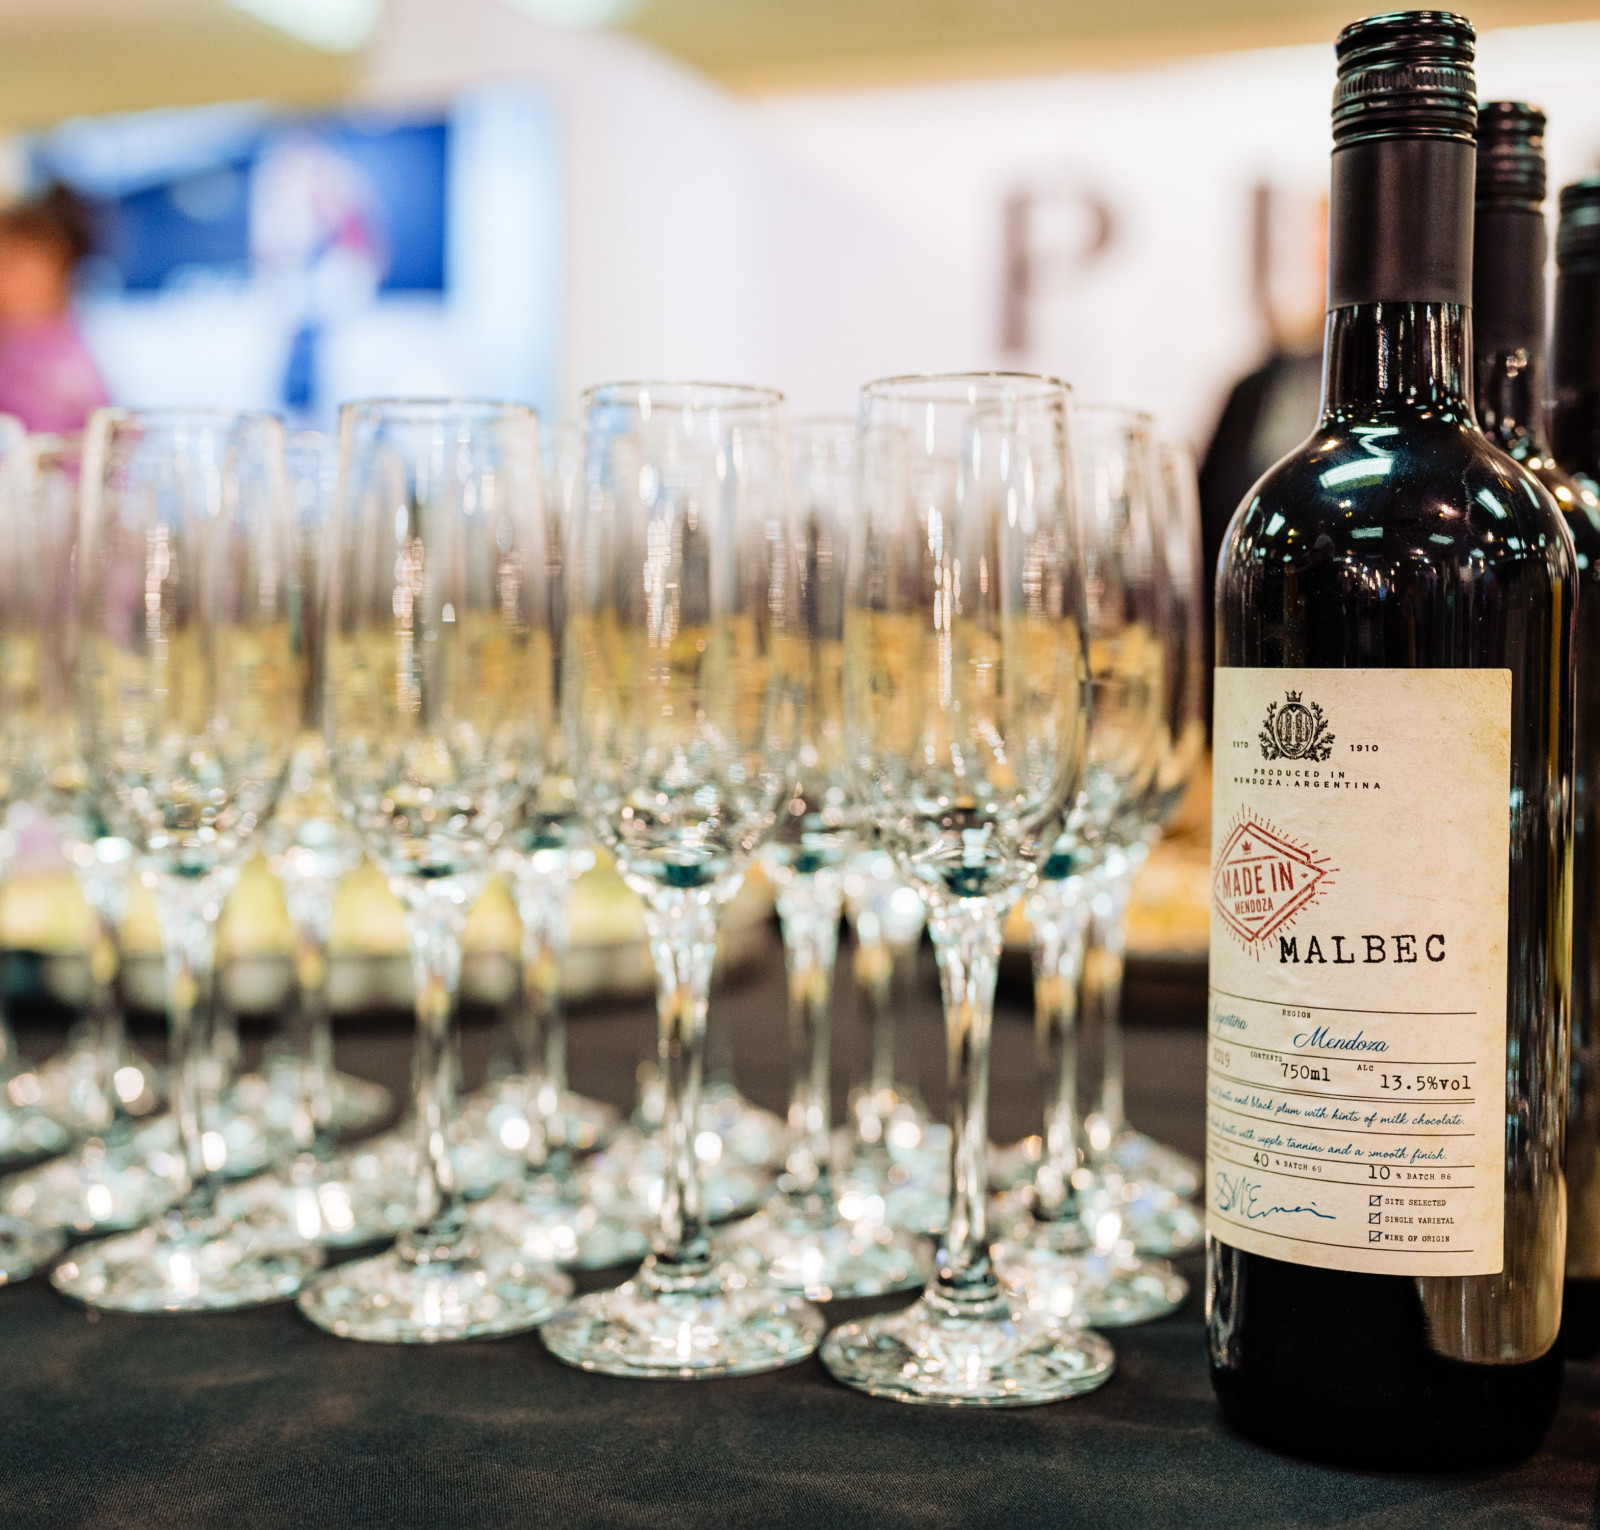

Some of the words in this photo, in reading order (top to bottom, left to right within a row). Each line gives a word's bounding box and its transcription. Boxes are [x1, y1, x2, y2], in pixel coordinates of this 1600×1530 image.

[1350, 744, 1379, 752] 1910
[1253, 768, 1320, 778] PRODUCED
[1330, 771, 1345, 779] IN
[1222, 864, 1266, 900] MADE
[1270, 861, 1295, 893] IN
[1234, 897, 1274, 915] MENDOZA
[1279, 933, 1447, 964] MALBEC
[1281, 1008, 1312, 1019] REGION
[1292, 1025, 1390, 1053] Mendoza
[1250, 1050, 1283, 1063] CONTENTS
[1280, 1062, 1331, 1082] 750ml
[1356, 1063, 1374, 1072] ALC
[1380, 1074, 1472, 1091] 13.5%vol
[1234, 1095, 1250, 1106] and
[1250, 1095, 1274, 1111] black
[1274, 1102, 1301, 1117] plum
[1304, 1106, 1329, 1119] with
[1331, 1108, 1361, 1122] hints
[1363, 1112, 1378, 1128] of
[1380, 1112, 1409, 1124] milk
[1411, 1112, 1465, 1126] chocolate.
[1238, 1127, 1256, 1140] with
[1257, 1134, 1284, 1149] supple
[1287, 1137, 1326, 1153] tannins
[1327, 1143, 1353, 1156] and
[1354, 1148, 1365, 1156] a
[1368, 1146, 1408, 1159] smooth
[1409, 1147, 1448, 1165] finish.
[1253, 1151, 1270, 1168] 40
[1283, 1160, 1308, 1171] BATCH
[1368, 1164, 1391, 1180] 10
[1406, 1172, 1435, 1180] BATCH
[1384, 1197, 1405, 1206] SITE
[1408, 1198, 1447, 1207] SELECTED
[1384, 1215, 1414, 1224] SINGLE
[1417, 1216, 1455, 1225] VARIETAL
[1384, 1233, 1404, 1242] WINE
[1407, 1234, 1418, 1242] OF
[1422, 1234, 1450, 1243] ORIGIN
